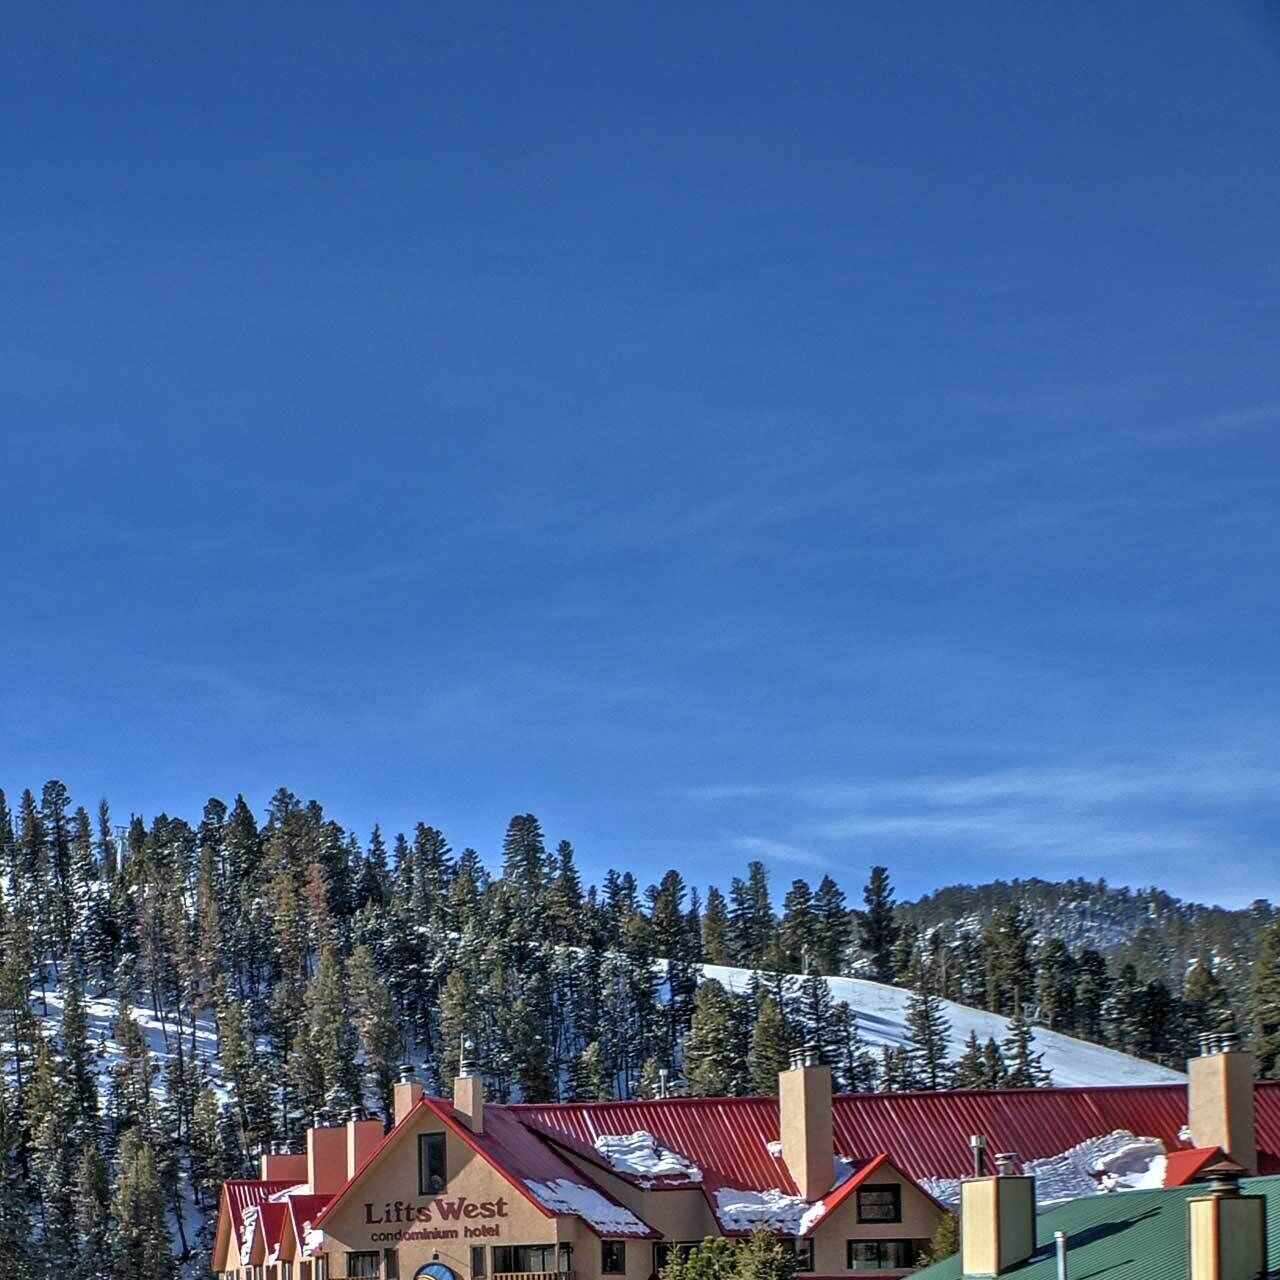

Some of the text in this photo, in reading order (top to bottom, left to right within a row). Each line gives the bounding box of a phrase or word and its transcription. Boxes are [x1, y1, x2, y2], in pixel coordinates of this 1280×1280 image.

[364, 1197, 508, 1223] Lifts West
[371, 1224, 500, 1242] condominium hotel
